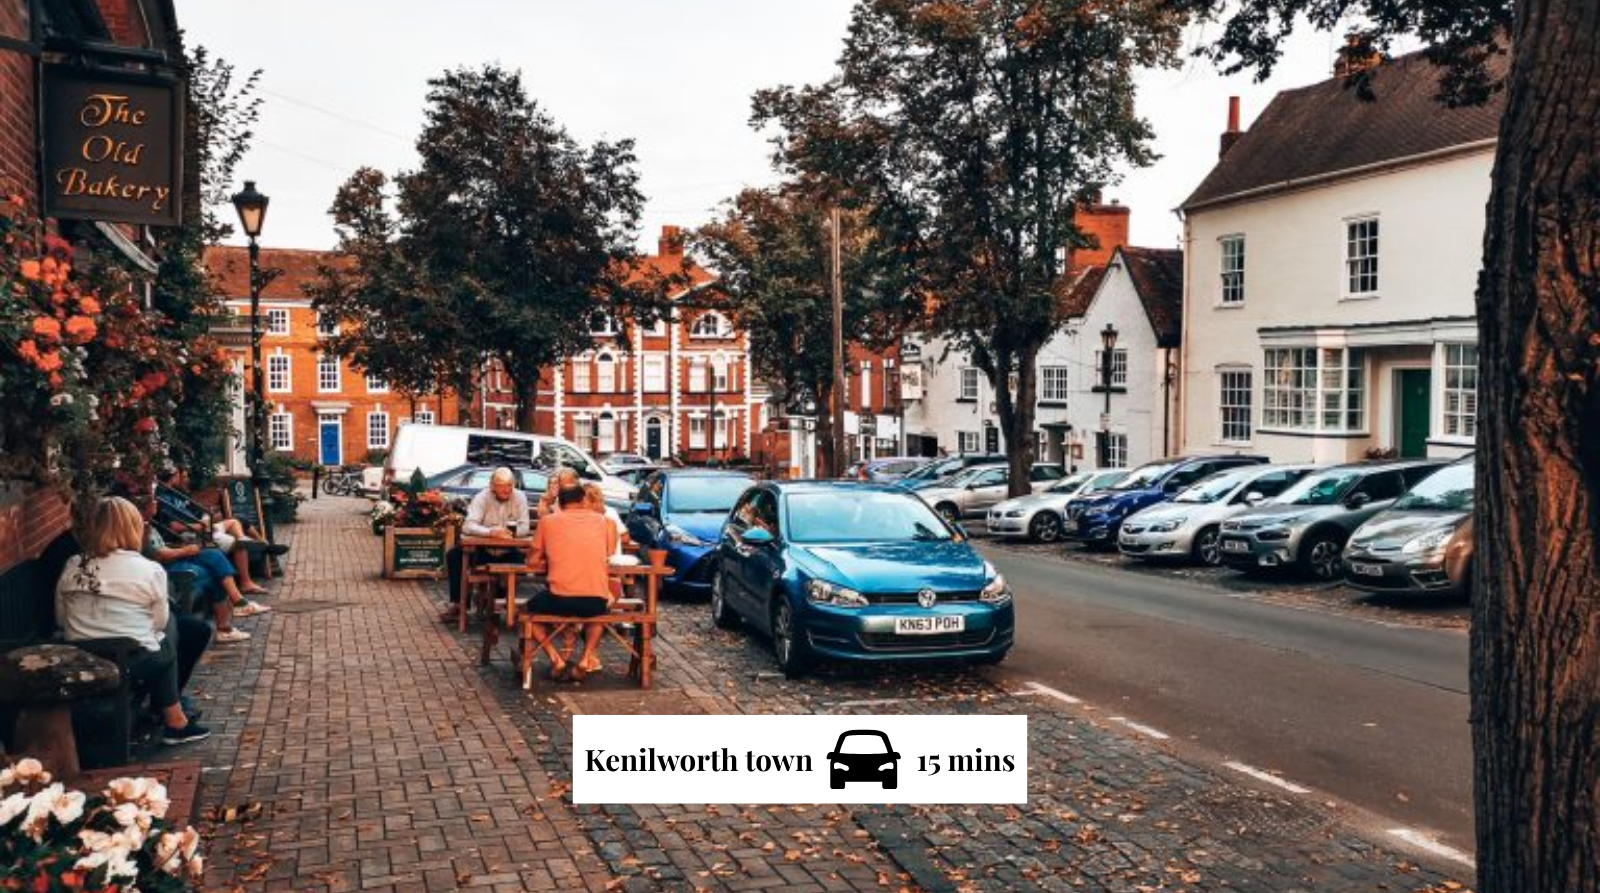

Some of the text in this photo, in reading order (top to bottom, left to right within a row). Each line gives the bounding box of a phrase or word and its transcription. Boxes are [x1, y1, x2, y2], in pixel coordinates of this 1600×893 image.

[80, 93, 146, 126] The
[82, 135, 144, 164] Old
[57, 168, 169, 213] Bakery
[900, 616, 960, 631] KN63 POH
